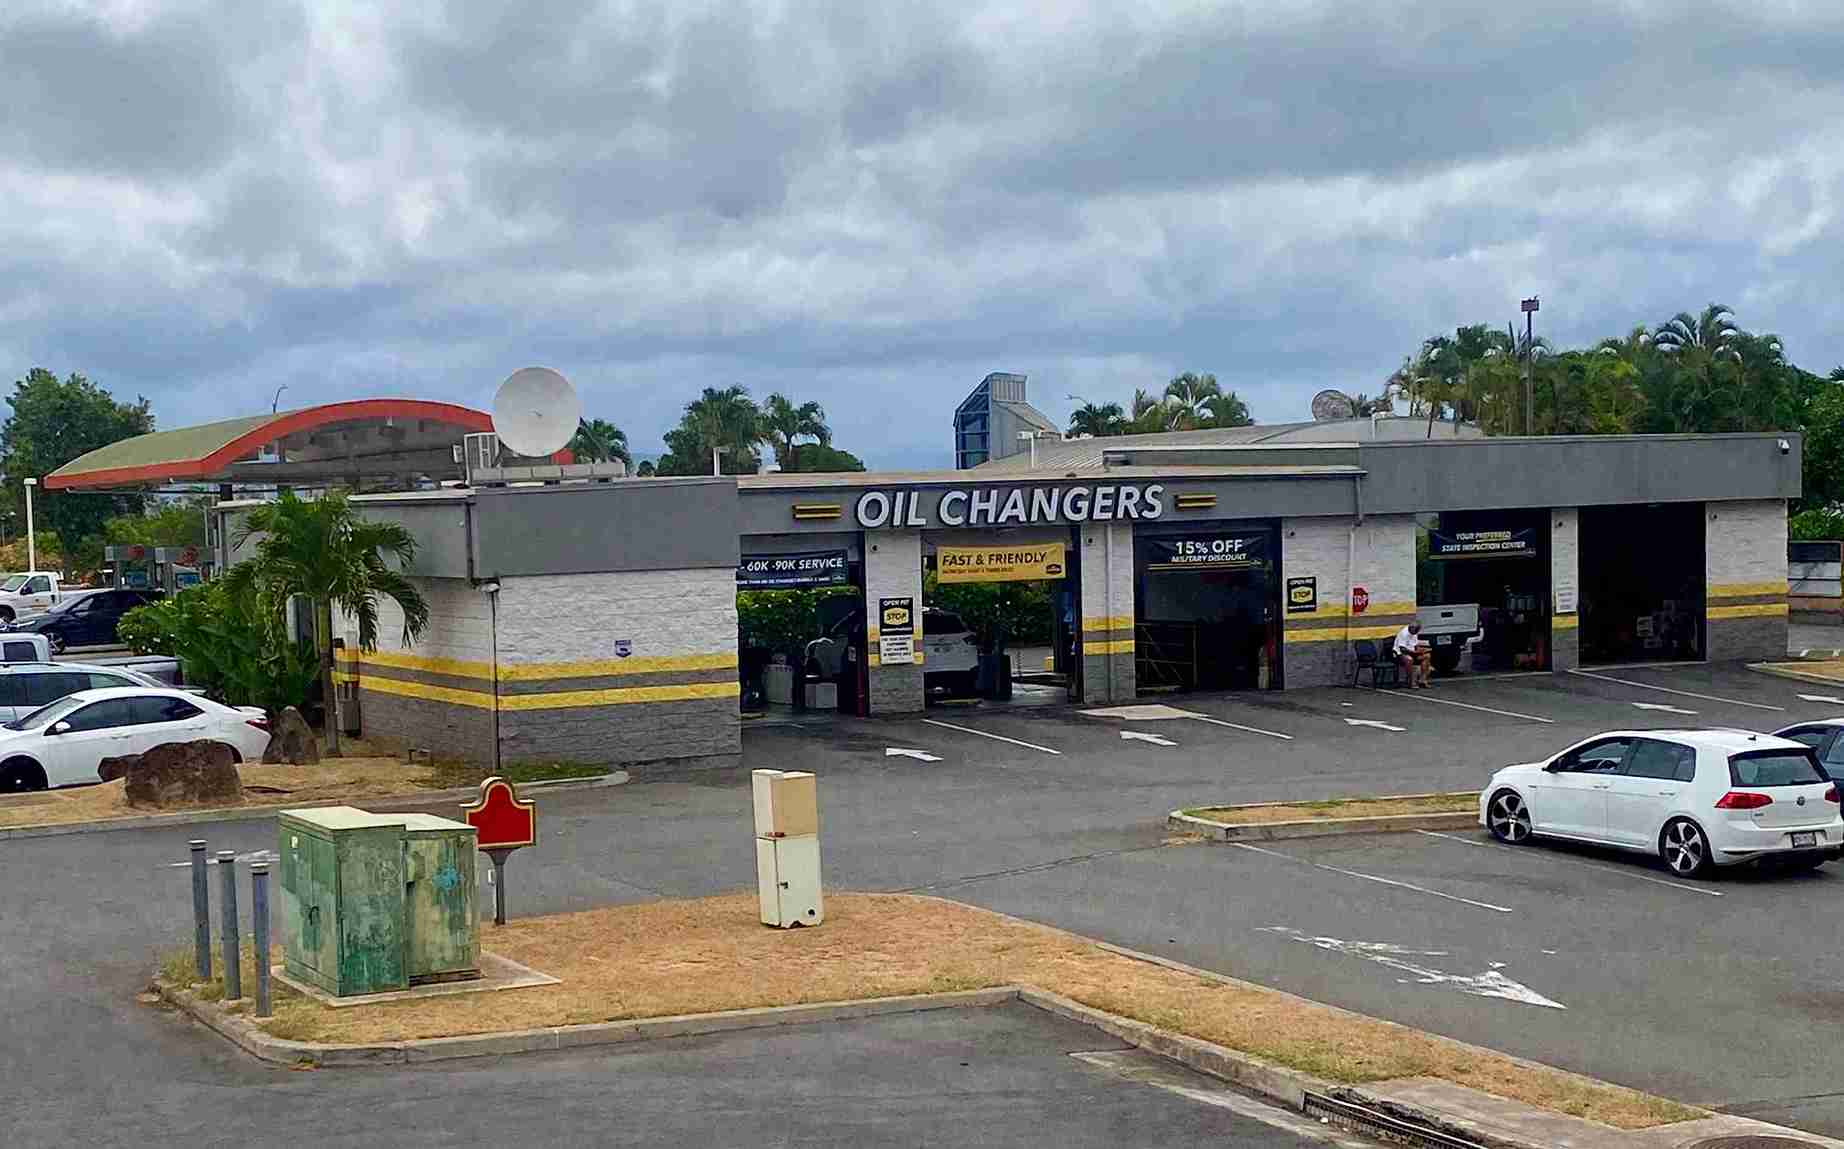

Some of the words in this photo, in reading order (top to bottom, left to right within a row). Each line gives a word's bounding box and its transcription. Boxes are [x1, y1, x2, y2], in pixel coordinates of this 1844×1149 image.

[857, 491, 927, 527] OIL
[939, 485, 1164, 525] CHANGERS
[1175, 541, 1209, 555] 15%
[1212, 539, 1244, 553] OFF
[798, 557, 843, 570] SERVICE
[942, 555, 974, 567] FAST
[975, 555, 985, 565] &
[988, 552, 1047, 565] FRIENDLY
[886, 612, 907, 621] STOP
